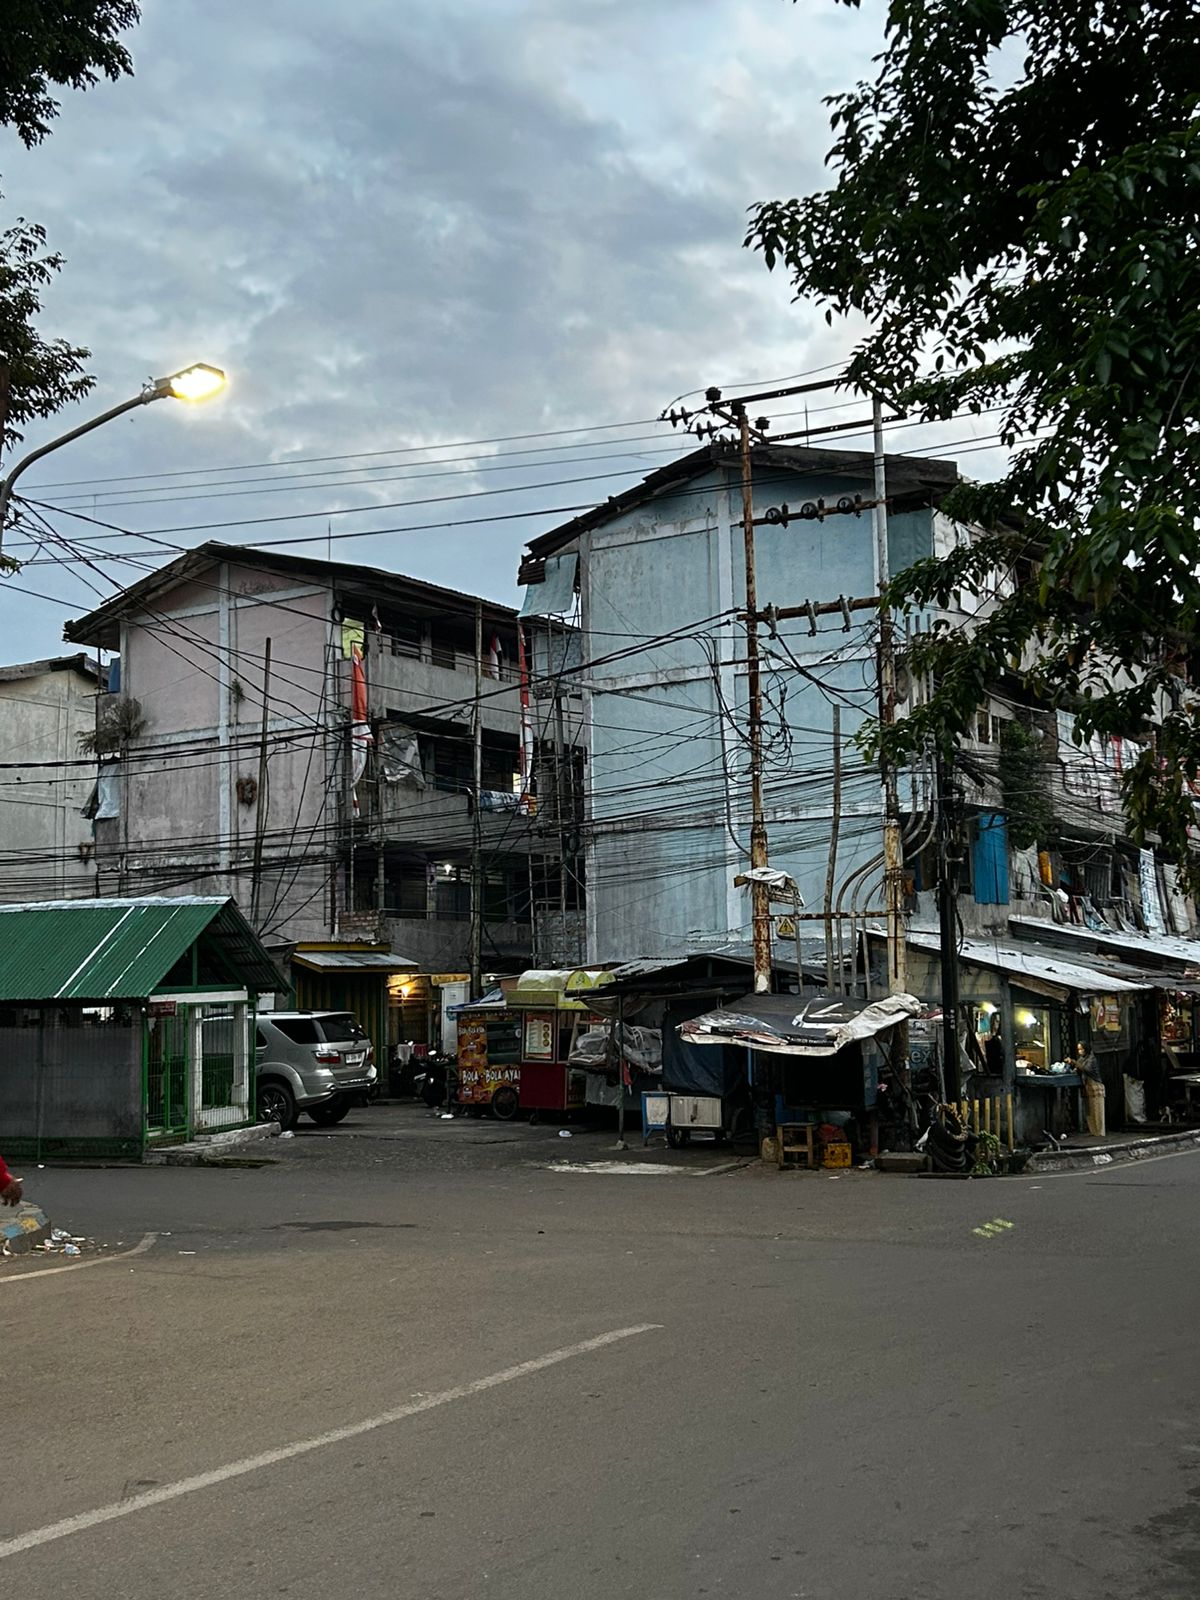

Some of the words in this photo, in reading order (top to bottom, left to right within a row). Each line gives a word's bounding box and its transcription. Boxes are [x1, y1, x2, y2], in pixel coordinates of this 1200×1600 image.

[462, 1070, 479, 1085] BOLA
[485, 1069, 502, 1083] BOLA
[504, 1069, 520, 1082] AYA
